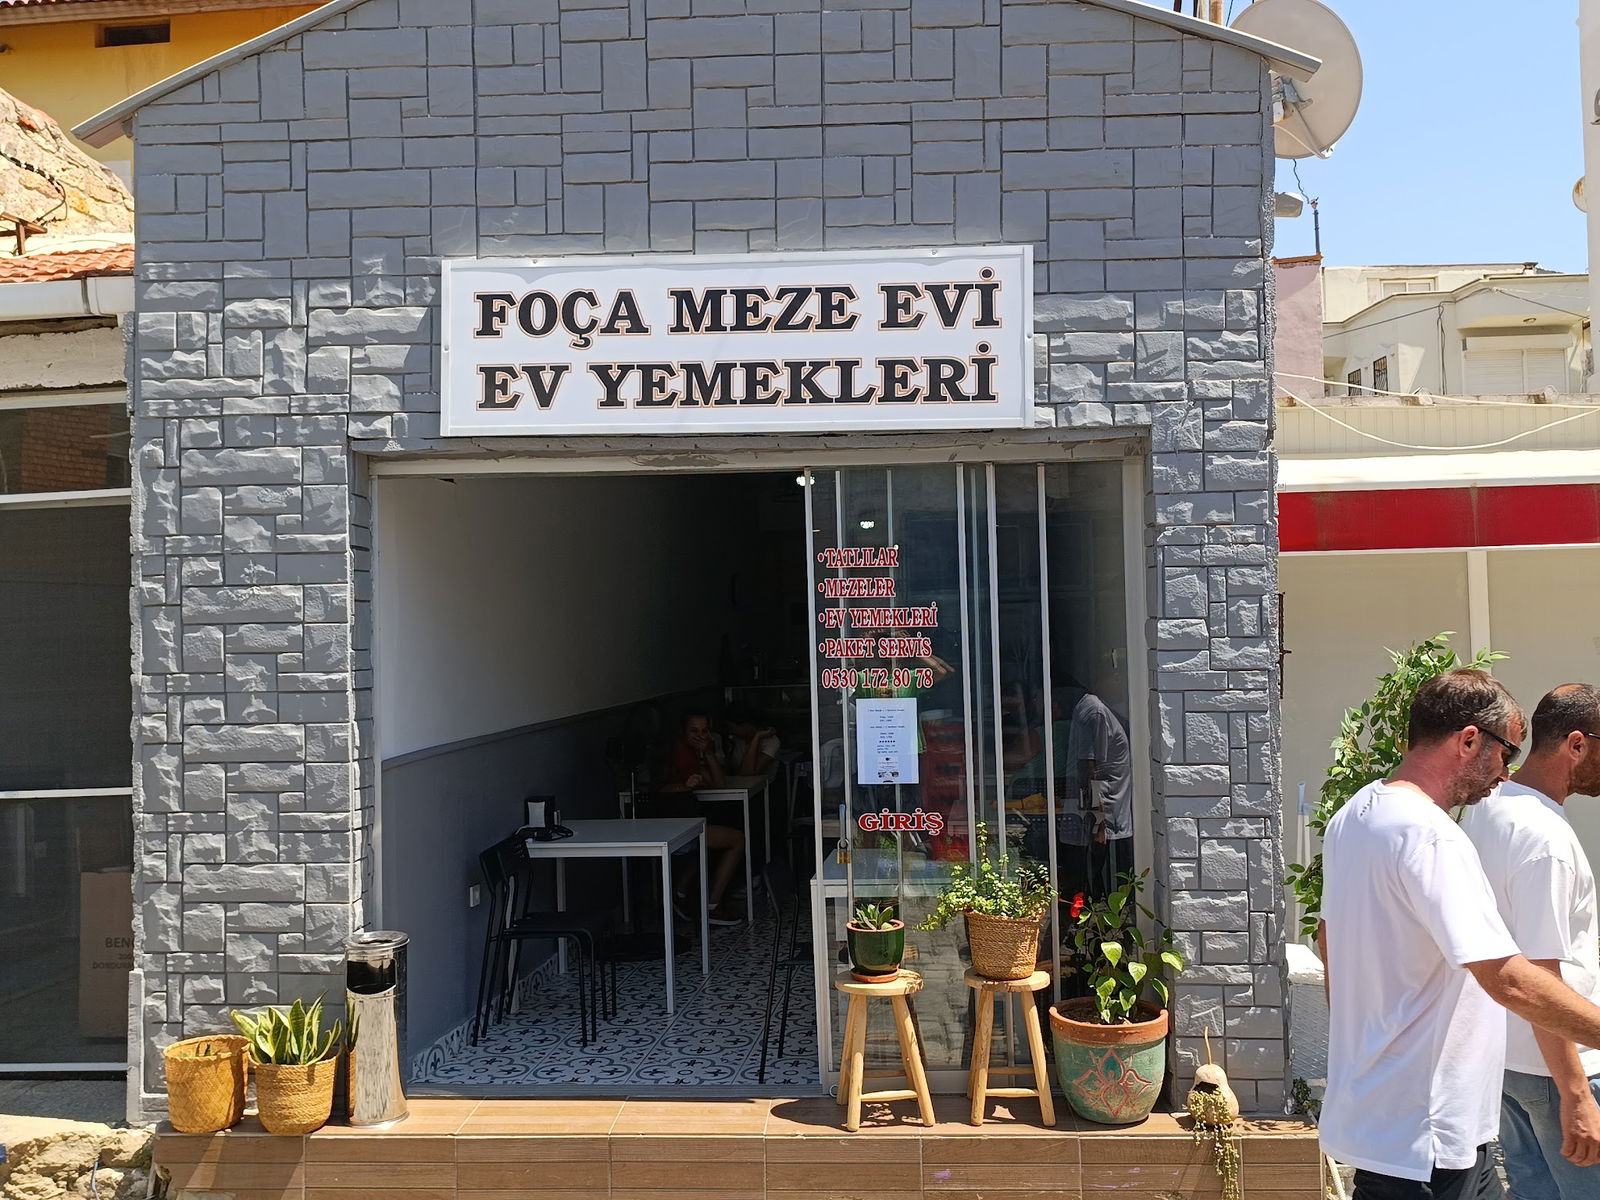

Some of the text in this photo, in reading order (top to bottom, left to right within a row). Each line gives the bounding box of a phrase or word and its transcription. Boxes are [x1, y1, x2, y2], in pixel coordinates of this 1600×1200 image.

[474, 266, 1003, 350] FOÇA MEZE EVİ
[476, 342, 999, 411] EV YEMEKLERİ
[825, 548, 899, 567] TATLILAR
[825, 578, 896, 598] MEZELER
[825, 601, 938, 628] EV YEMEKLERİ
[825, 631, 933, 659] PAKET SERVİS
[822, 667, 934, 688] 0530 172 80 78
[858, 807, 944, 836] GİRİŞ
